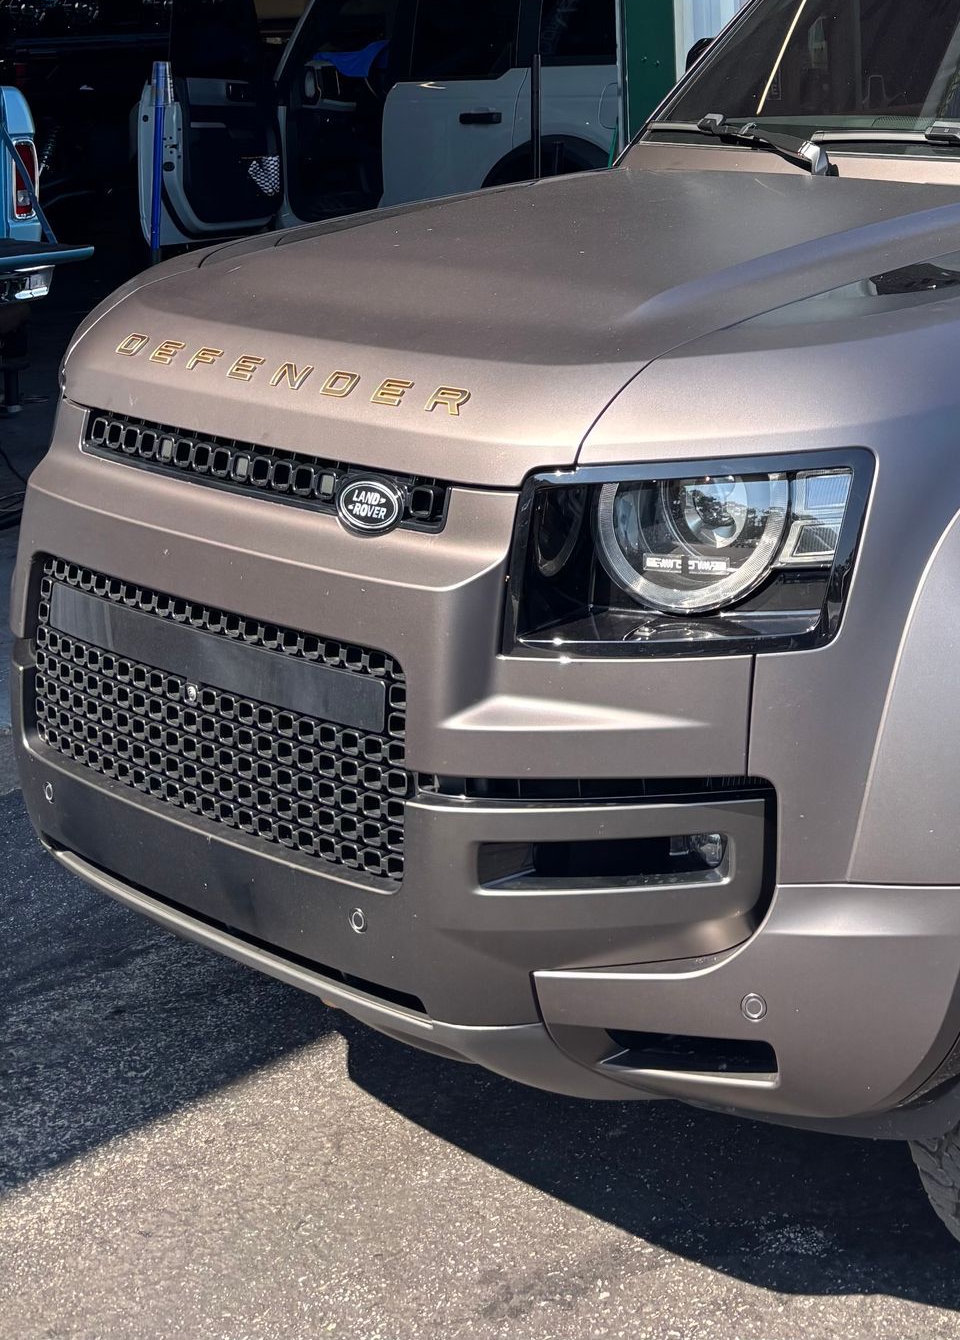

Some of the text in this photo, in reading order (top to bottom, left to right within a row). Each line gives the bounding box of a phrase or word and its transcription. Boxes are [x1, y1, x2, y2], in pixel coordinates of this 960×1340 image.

[115, 333, 471, 416] DEFENDER
[353, 489, 381, 506] LAND
[353, 503, 387, 520] ROVER
